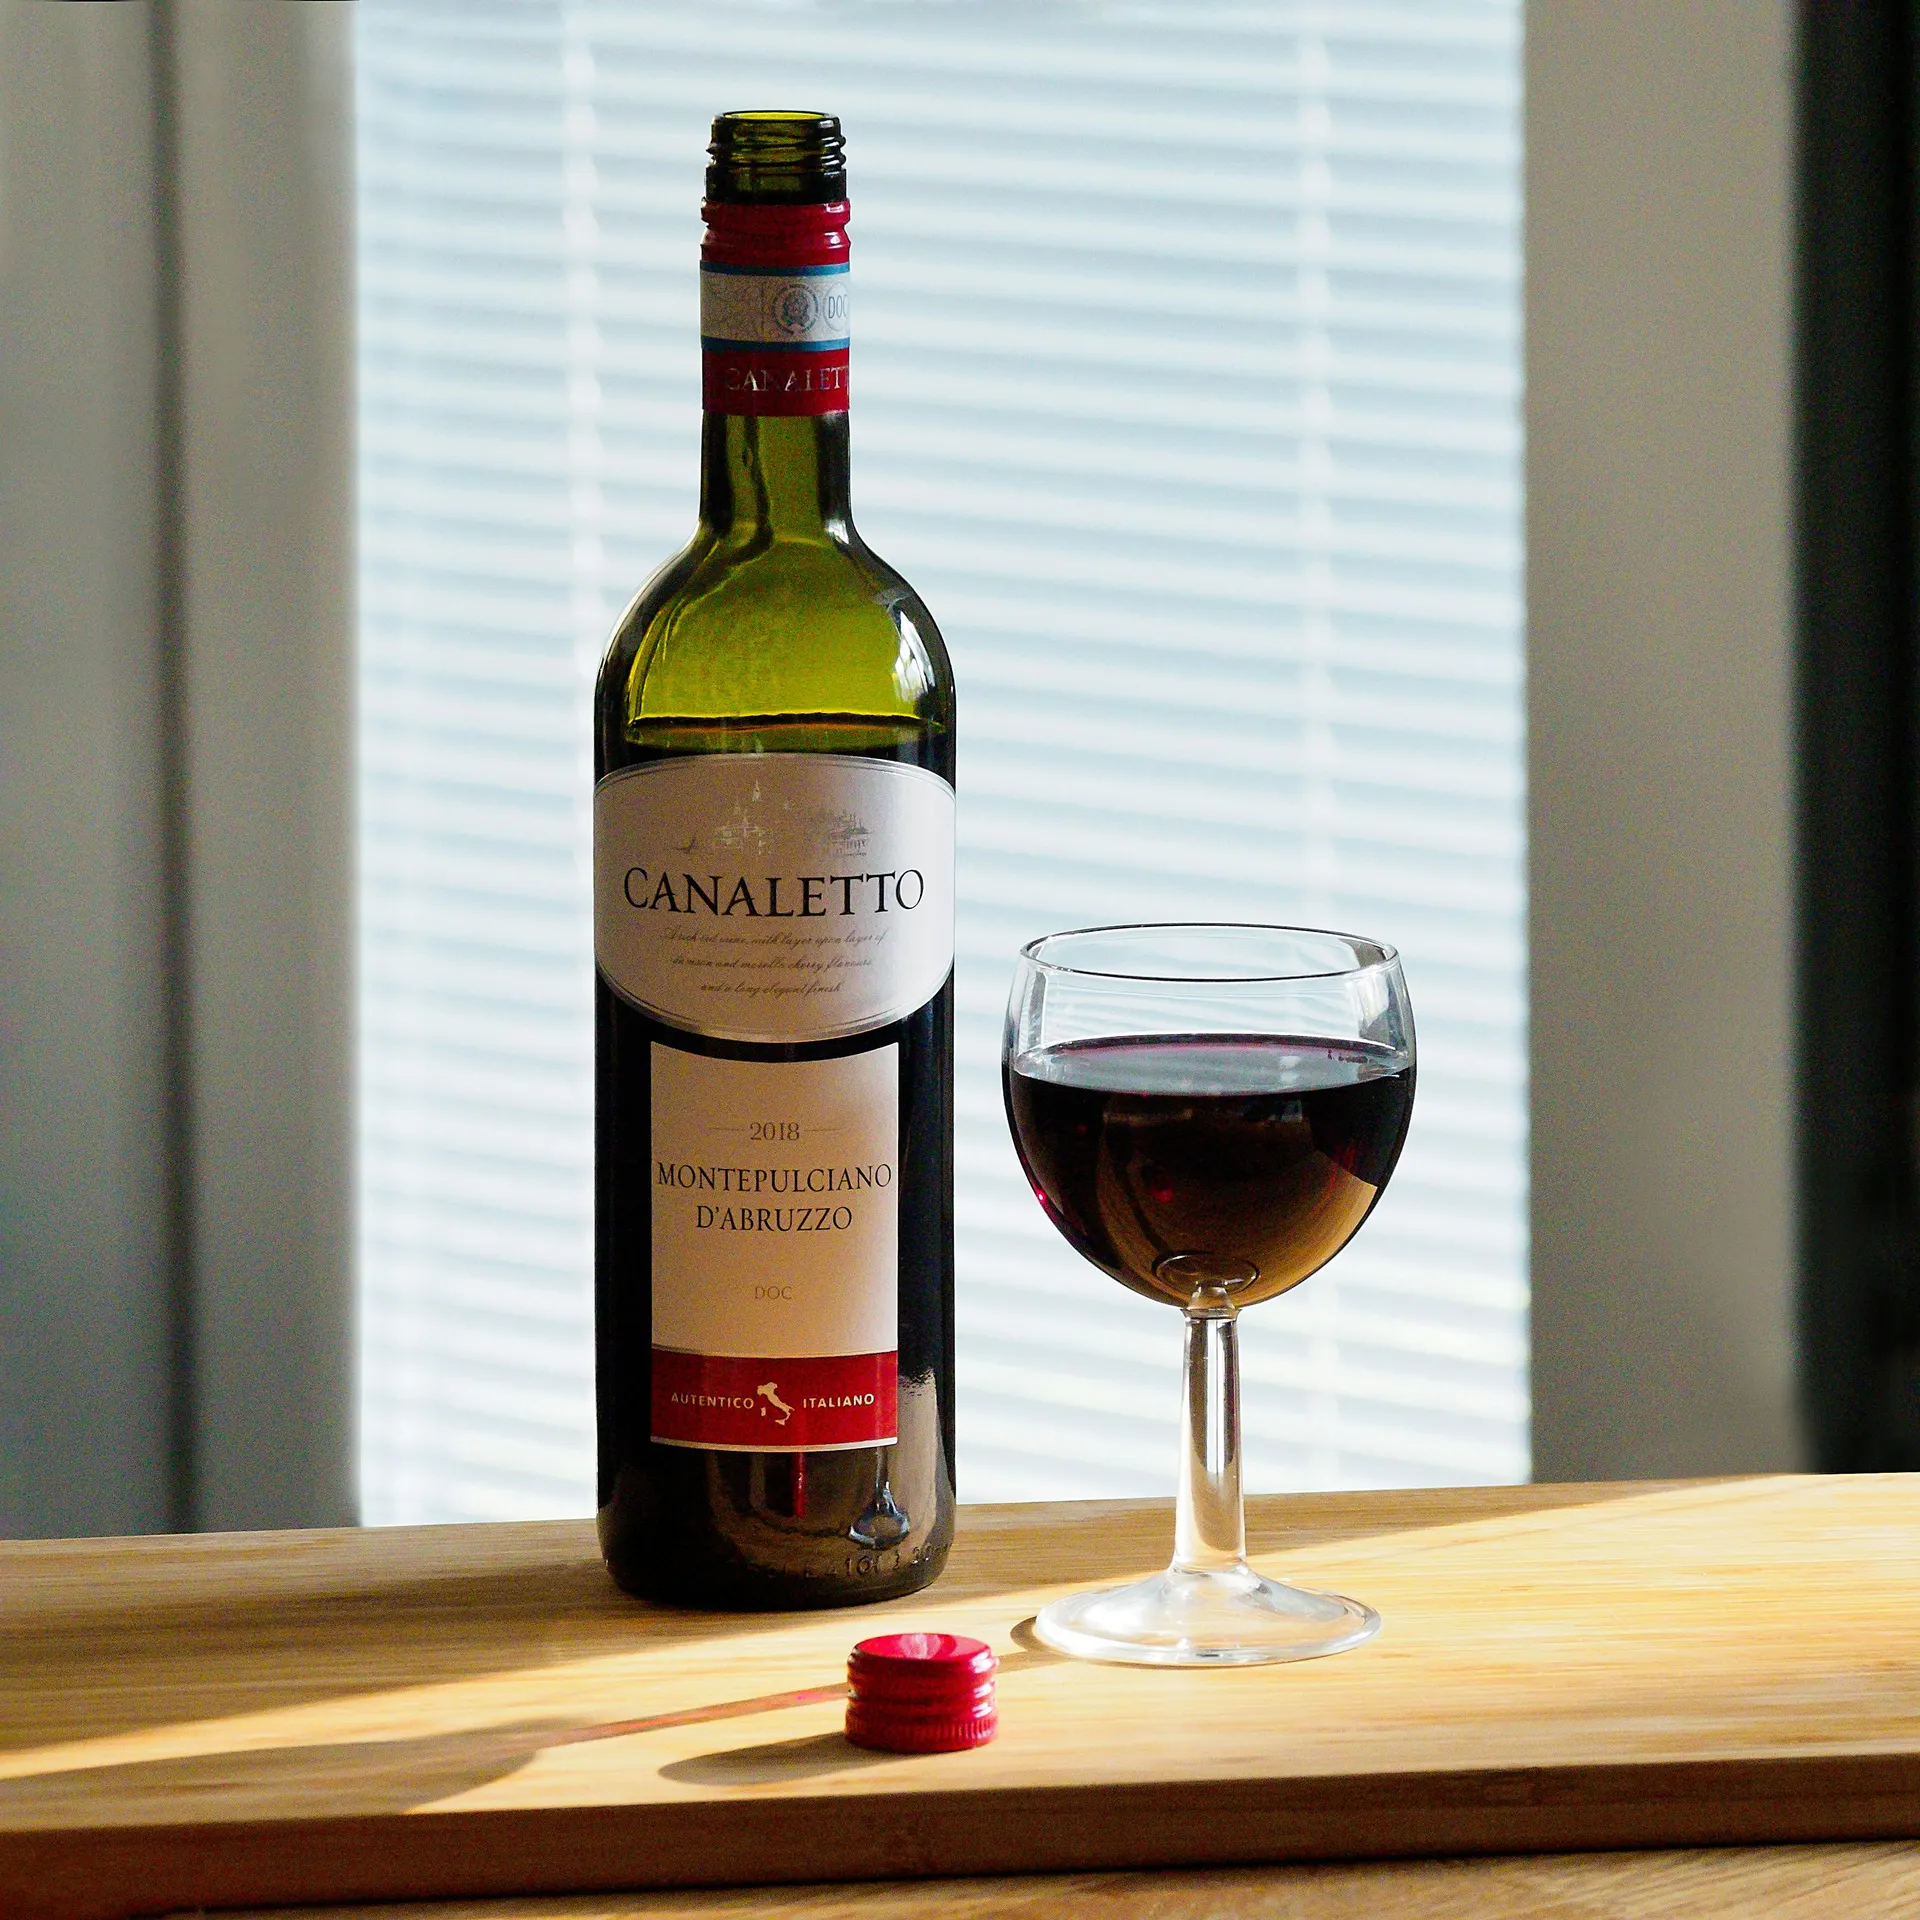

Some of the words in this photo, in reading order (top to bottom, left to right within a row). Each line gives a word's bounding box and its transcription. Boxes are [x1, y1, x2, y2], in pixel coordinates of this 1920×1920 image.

[623, 867, 925, 917] CANALETTO
[781, 931, 813, 950] layer
[815, 935, 842, 949] upon
[844, 929, 873, 948] layer
[874, 927, 889, 946] of
[715, 956, 742, 968] and
[787, 955, 823, 973] cherry
[824, 955, 872, 973] flavours
[734, 981, 761, 998] long
[763, 981, 807, 999] elegant
[804, 980, 845, 998] finish
[749, 1121, 800, 1141] 2018
[657, 1161, 892, 1193] MONTEPULCIANO
[696, 1204, 853, 1232] D'ABRUZZO
[754, 1285, 793, 1301] DOC
[671, 1392, 755, 1410] AUTENTICO
[803, 1393, 875, 1409] ITALIANO
